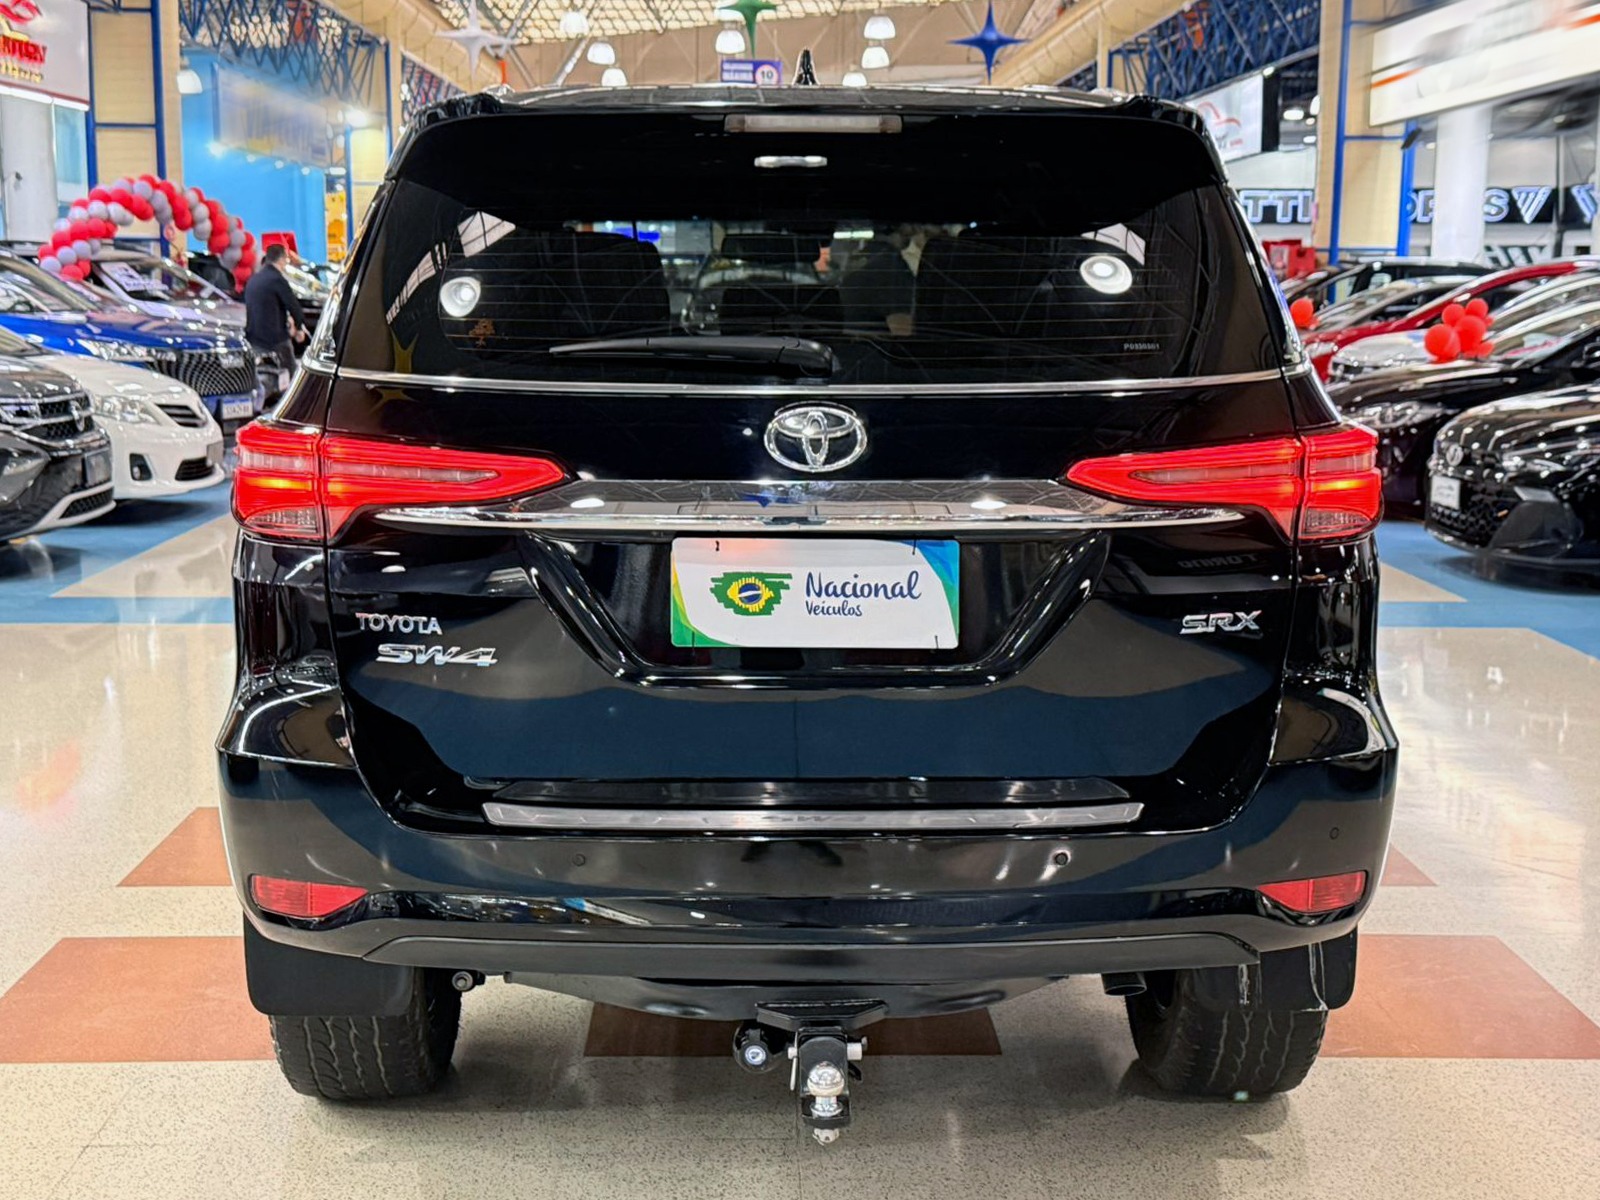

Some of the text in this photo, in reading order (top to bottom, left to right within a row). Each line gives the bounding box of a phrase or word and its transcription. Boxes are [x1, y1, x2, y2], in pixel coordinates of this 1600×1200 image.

[760, 69, 774, 79] 10
[805, 570, 922, 600] Nacional
[354, 612, 443, 635] TOYOTA
[1179, 609, 1262, 634] SRX
[375, 643, 498, 667] SW4
